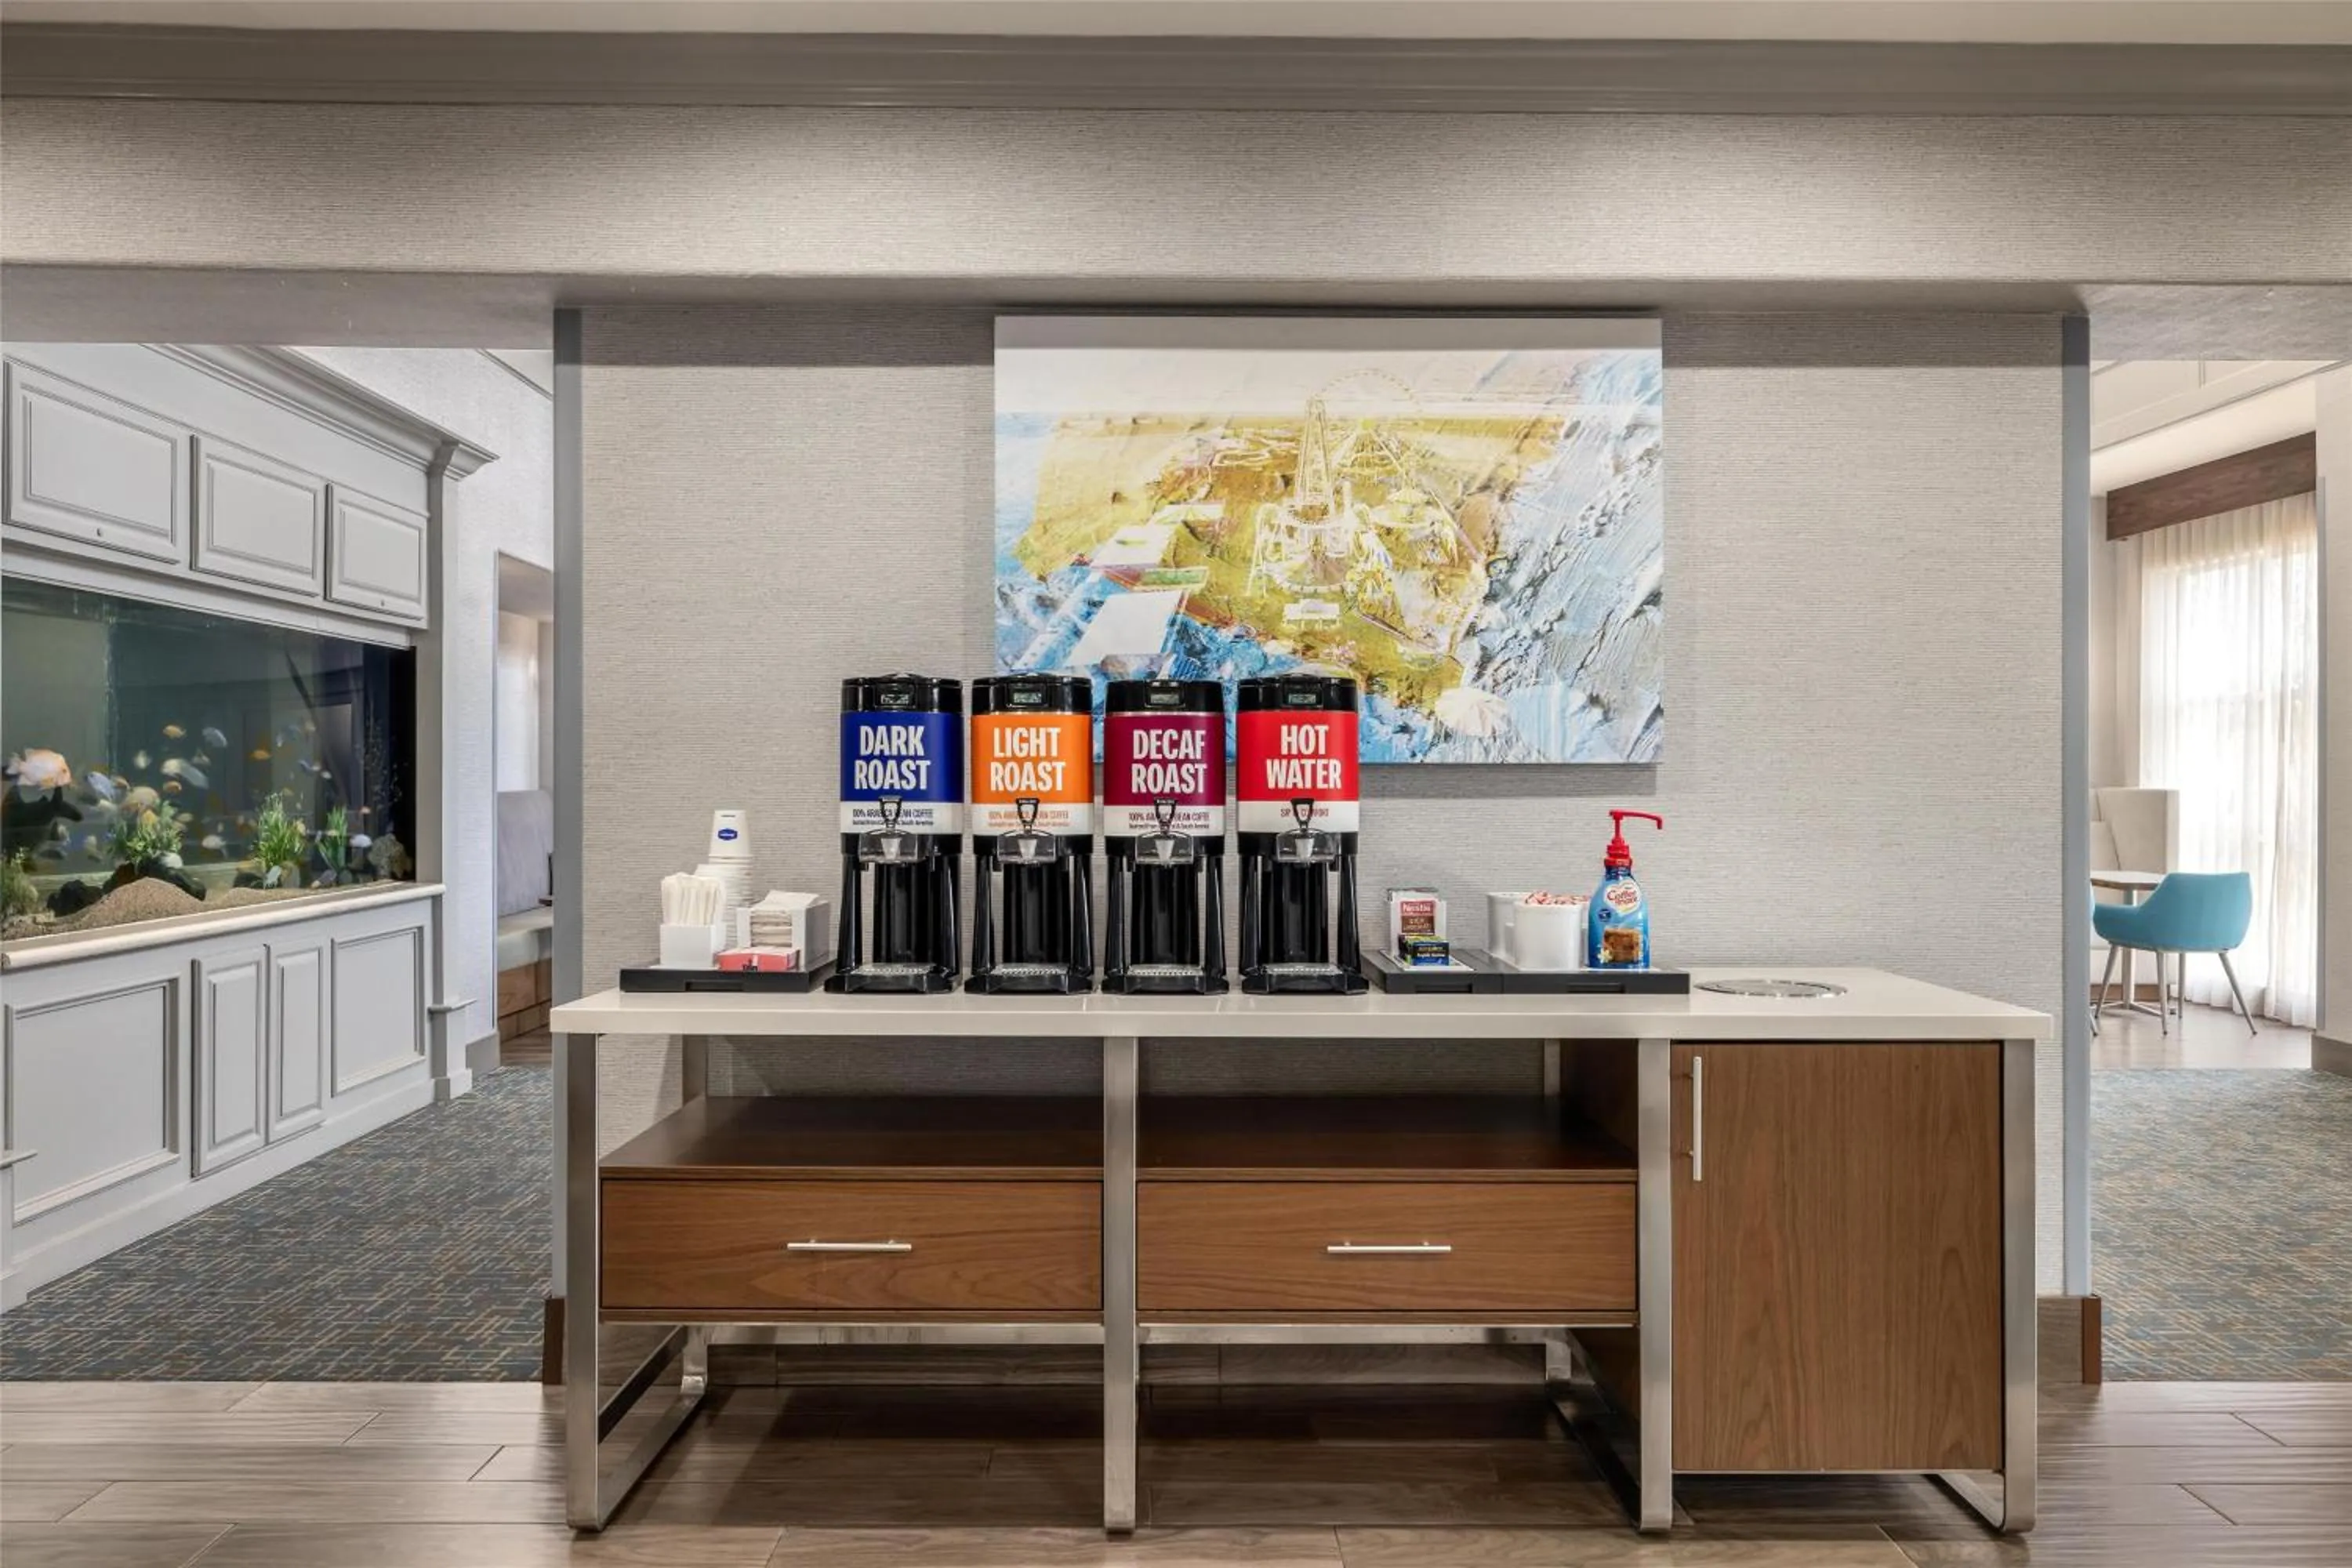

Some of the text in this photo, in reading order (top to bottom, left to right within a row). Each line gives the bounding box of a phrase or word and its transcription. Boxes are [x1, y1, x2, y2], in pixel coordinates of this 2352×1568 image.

[859, 725, 925, 757] DARK
[993, 728, 1061, 757] LIGHT
[1133, 729, 1207, 760] DECAF
[1280, 724, 1329, 755] HOT
[855, 760, 931, 790] ROAST
[990, 761, 1066, 792] ROAST
[1131, 763, 1207, 794] ROAST
[1266, 759, 1342, 789] WATER
